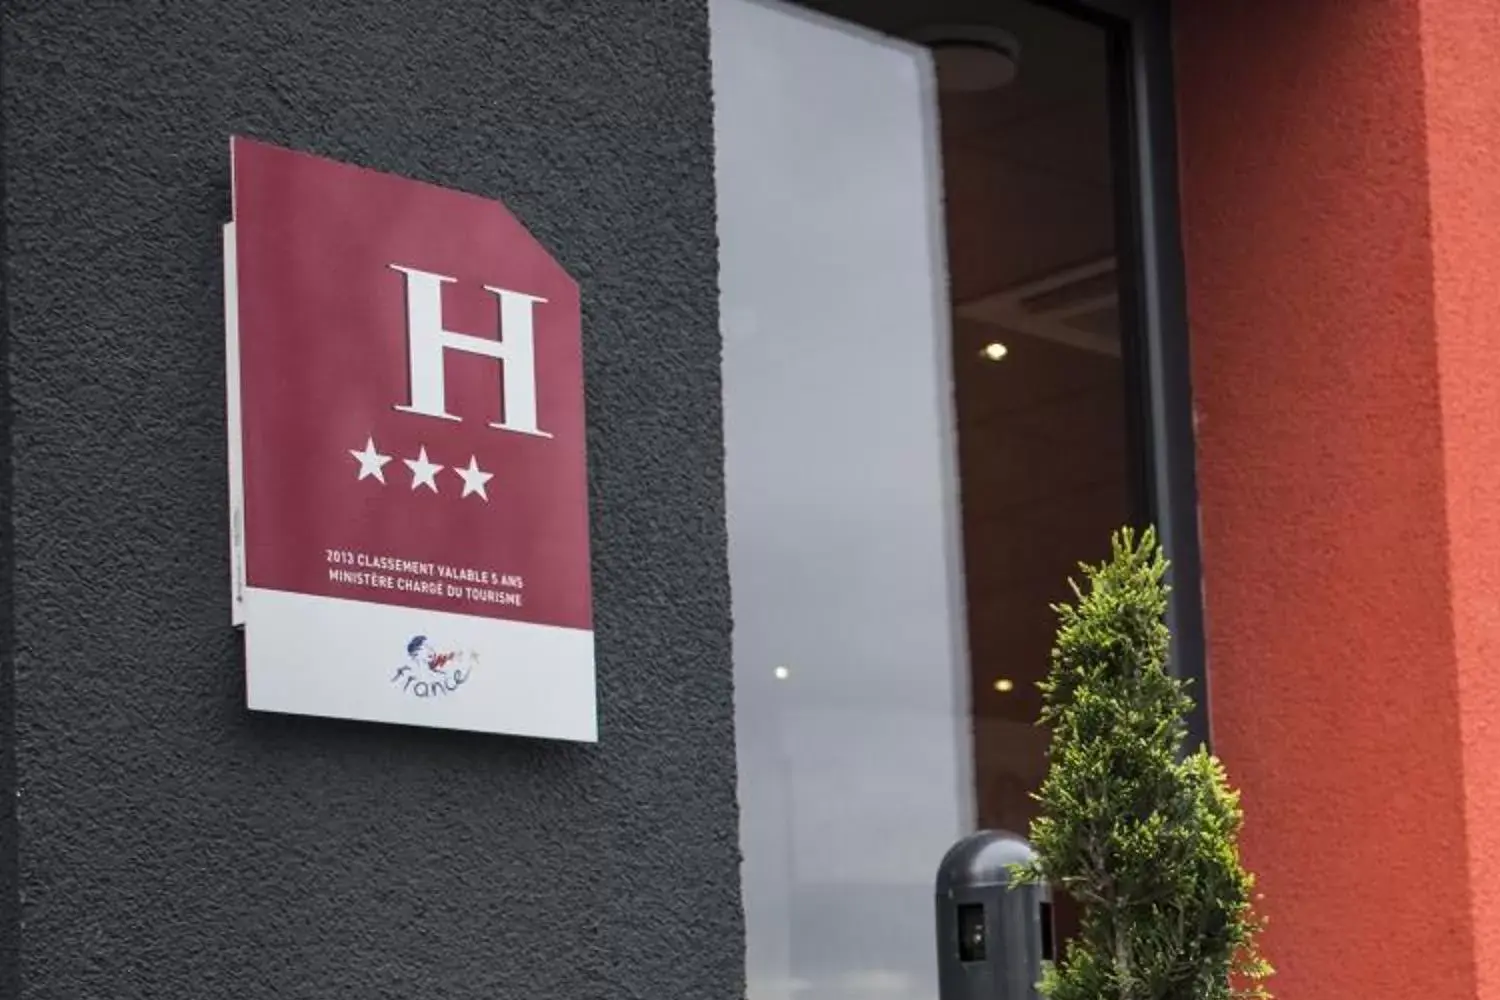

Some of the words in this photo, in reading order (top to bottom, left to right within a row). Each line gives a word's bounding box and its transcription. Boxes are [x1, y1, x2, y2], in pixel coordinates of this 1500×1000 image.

[389, 263, 554, 438] H
[325, 549, 355, 565] 2013
[357, 553, 434, 576] CLASSEMENT
[437, 565, 489, 584] VALABLE
[491, 572, 499, 585] 5
[501, 575, 523, 589] ANS
[328, 568, 395, 589] MINISTÈRE
[447, 584, 463, 598] DU
[465, 587, 522, 607] TOURISME
